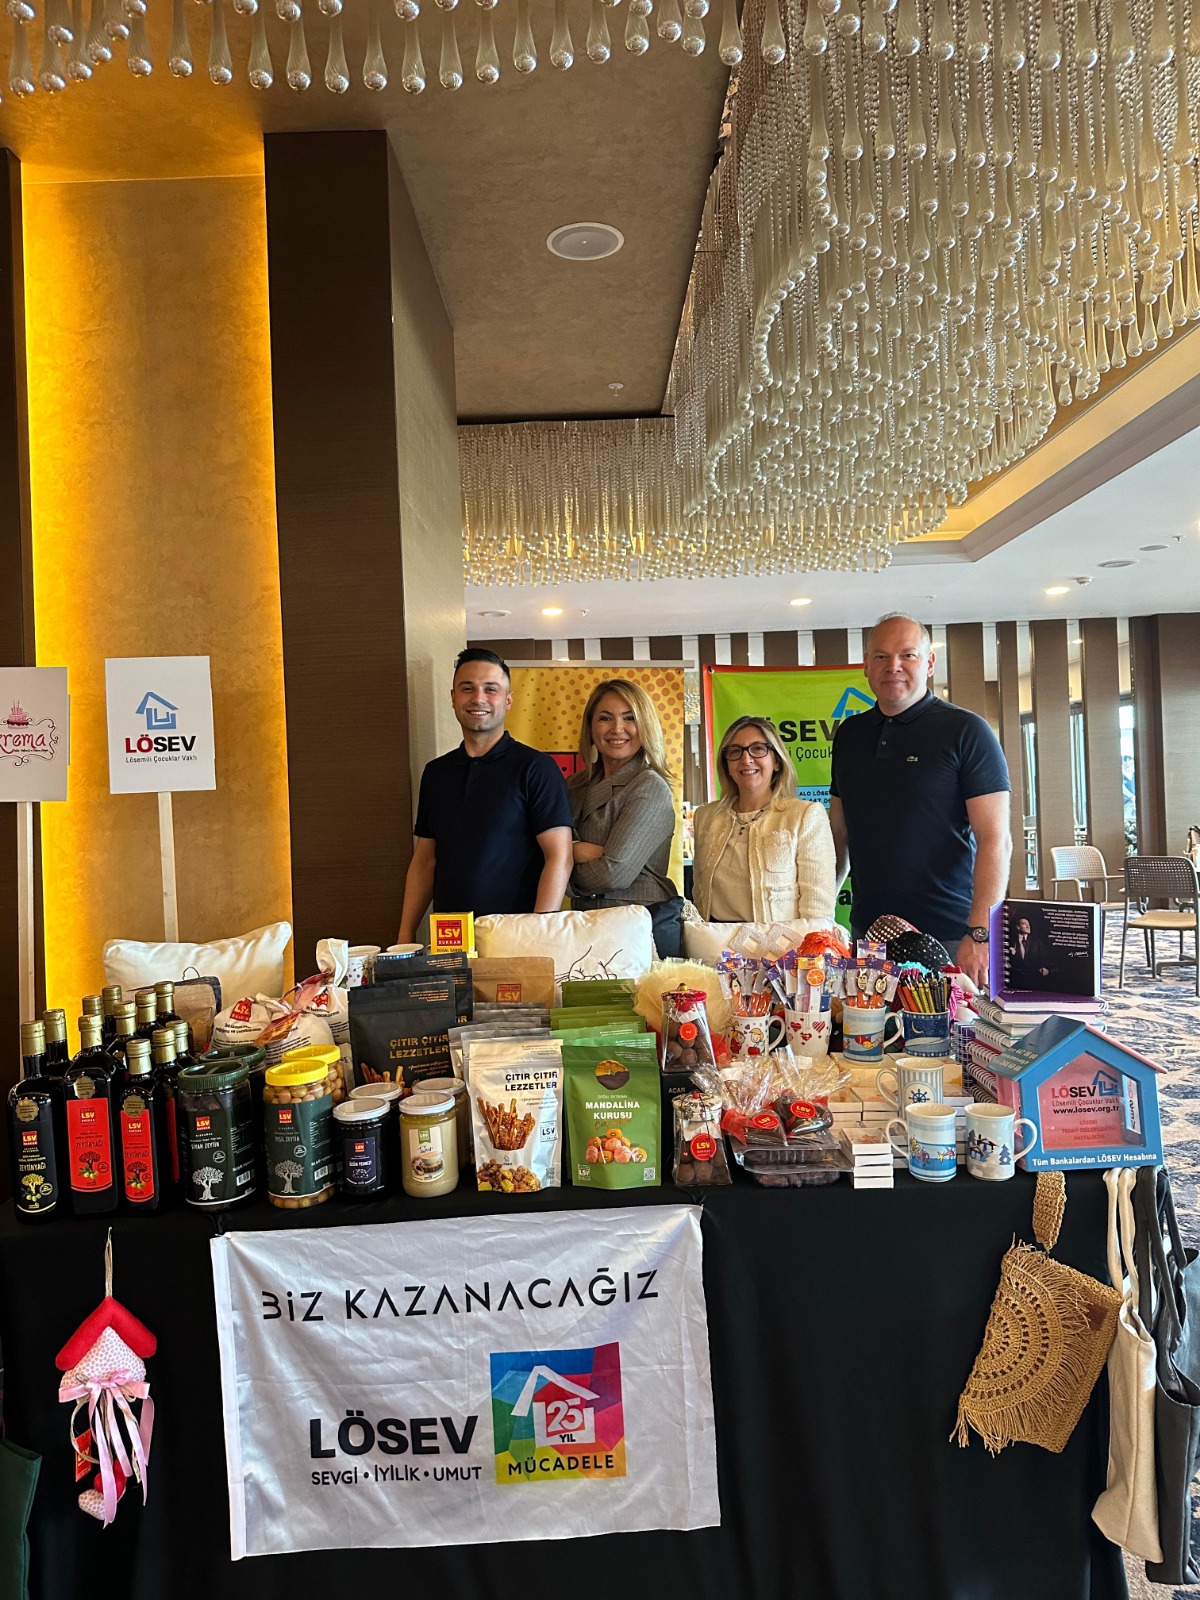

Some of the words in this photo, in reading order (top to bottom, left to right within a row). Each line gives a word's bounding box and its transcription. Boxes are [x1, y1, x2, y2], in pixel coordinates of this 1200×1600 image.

[765, 716, 841, 742] SEV
[125, 734, 196, 753] LÖSEV
[153, 755, 180, 763] Çocuklar
[438, 928, 461, 938] LSV
[498, 991, 520, 1001] LSV
[389, 1037, 419, 1049] ÇITIR
[421, 1034, 449, 1047] ÇITIR
[389, 1044, 449, 1059] LEZZETLER
[505, 1073, 531, 1083] ÇITIR
[533, 1071, 558, 1082] ÇITIR
[505, 1081, 557, 1092] LEZZETLER
[1051, 1085, 1097, 1099] LÖSEV
[585, 1099, 641, 1110] MANDALİNA
[1053, 1105, 1120, 1114] www.losev.org.tr
[593, 1111, 633, 1120] KURUSU
[542, 1127, 555, 1136] LSV
[1032, 1158, 1049, 1166] Tüm
[1050, 1156, 1096, 1165] Bankalardan
[1097, 1153, 1121, 1163] LÖSEV
[1123, 1153, 1157, 1162] Hesabına
[345, 1267, 659, 1320] KAZANACAĞIZ
[546, 1397, 584, 1433] 25
[310, 1410, 479, 1459] LÖSEV
[559, 1433, 576, 1443] YIL
[507, 1454, 614, 1476] MÜCADELE
[311, 1467, 358, 1486] SEVGİ
[375, 1464, 420, 1482] İYİLİK
[433, 1466, 483, 1482] UMUT
